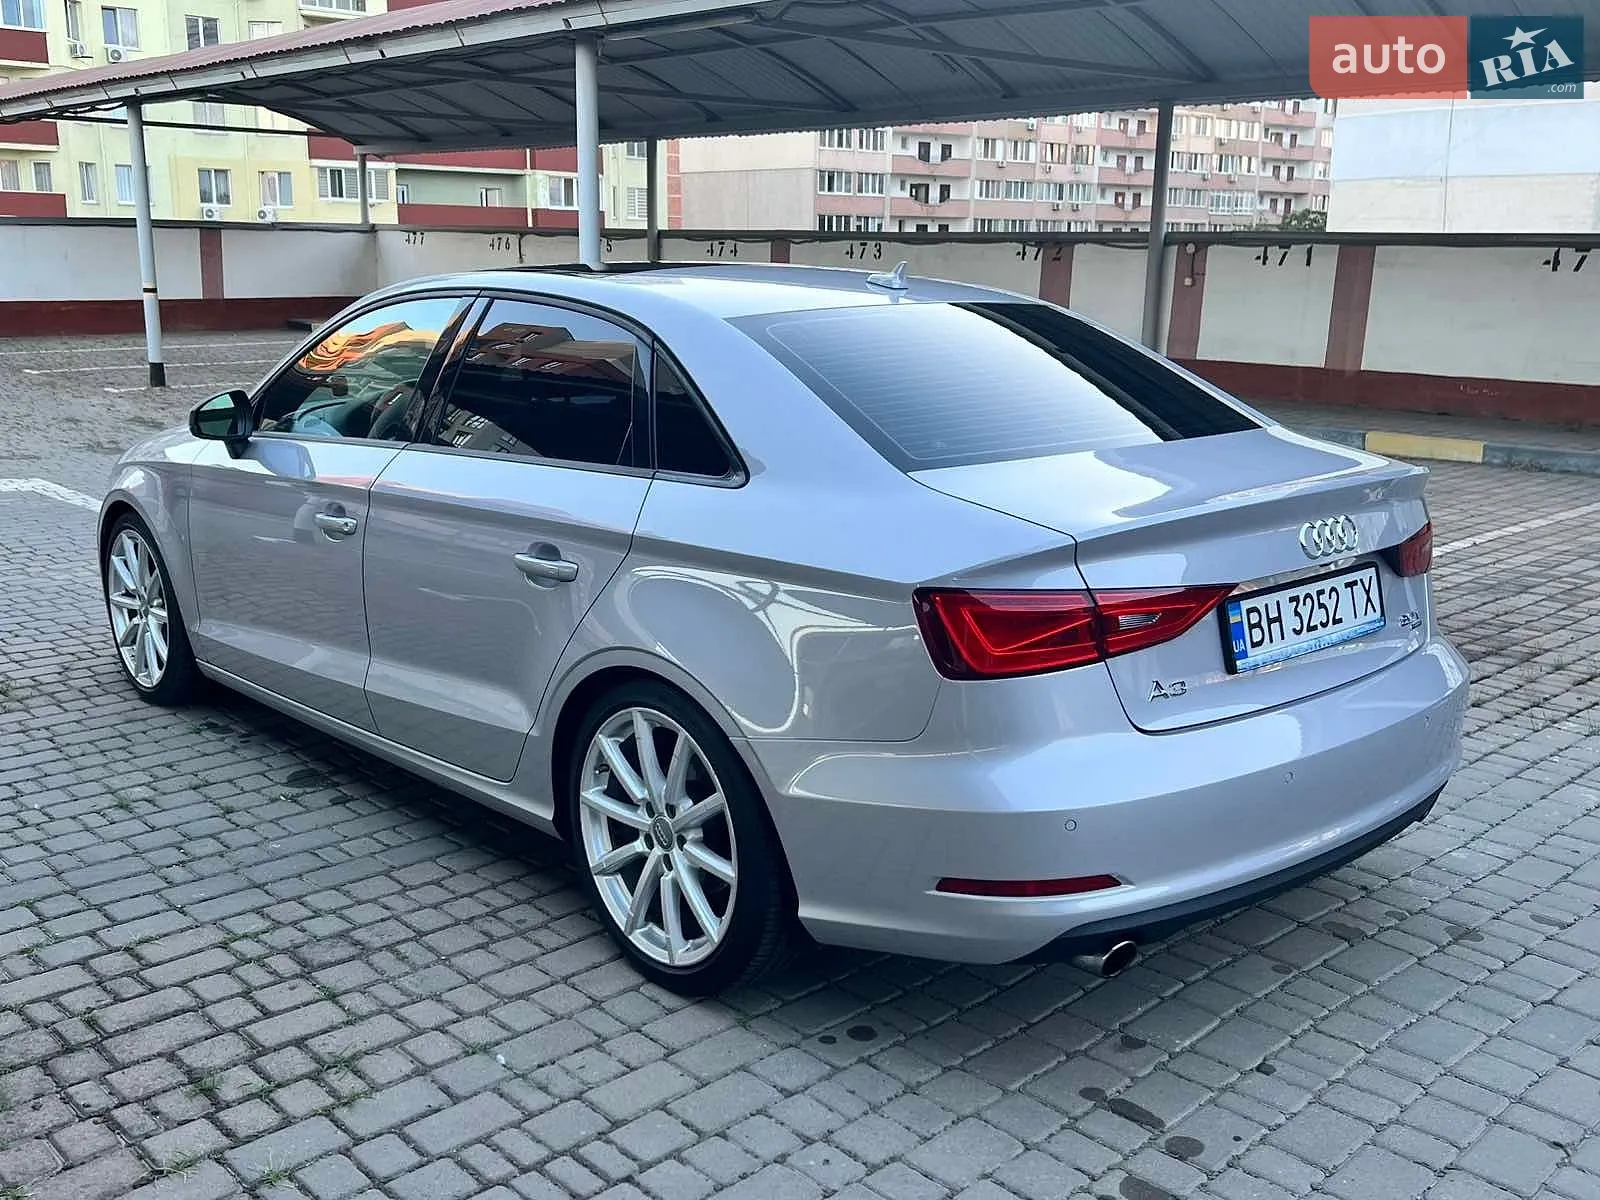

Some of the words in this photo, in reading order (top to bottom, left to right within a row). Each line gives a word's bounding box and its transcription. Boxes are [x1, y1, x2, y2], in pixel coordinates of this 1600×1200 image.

[489, 237, 510, 250] 476
[707, 242, 738, 257] 474
[845, 242, 882, 260] 473
[1255, 244, 1314, 266] 471
[1245, 600, 1285, 649] BH
[1288, 586, 1343, 636] 3252
[1344, 575, 1377, 619] TX
[1232, 639, 1246, 653] UA
[1148, 680, 1187, 702] A3
